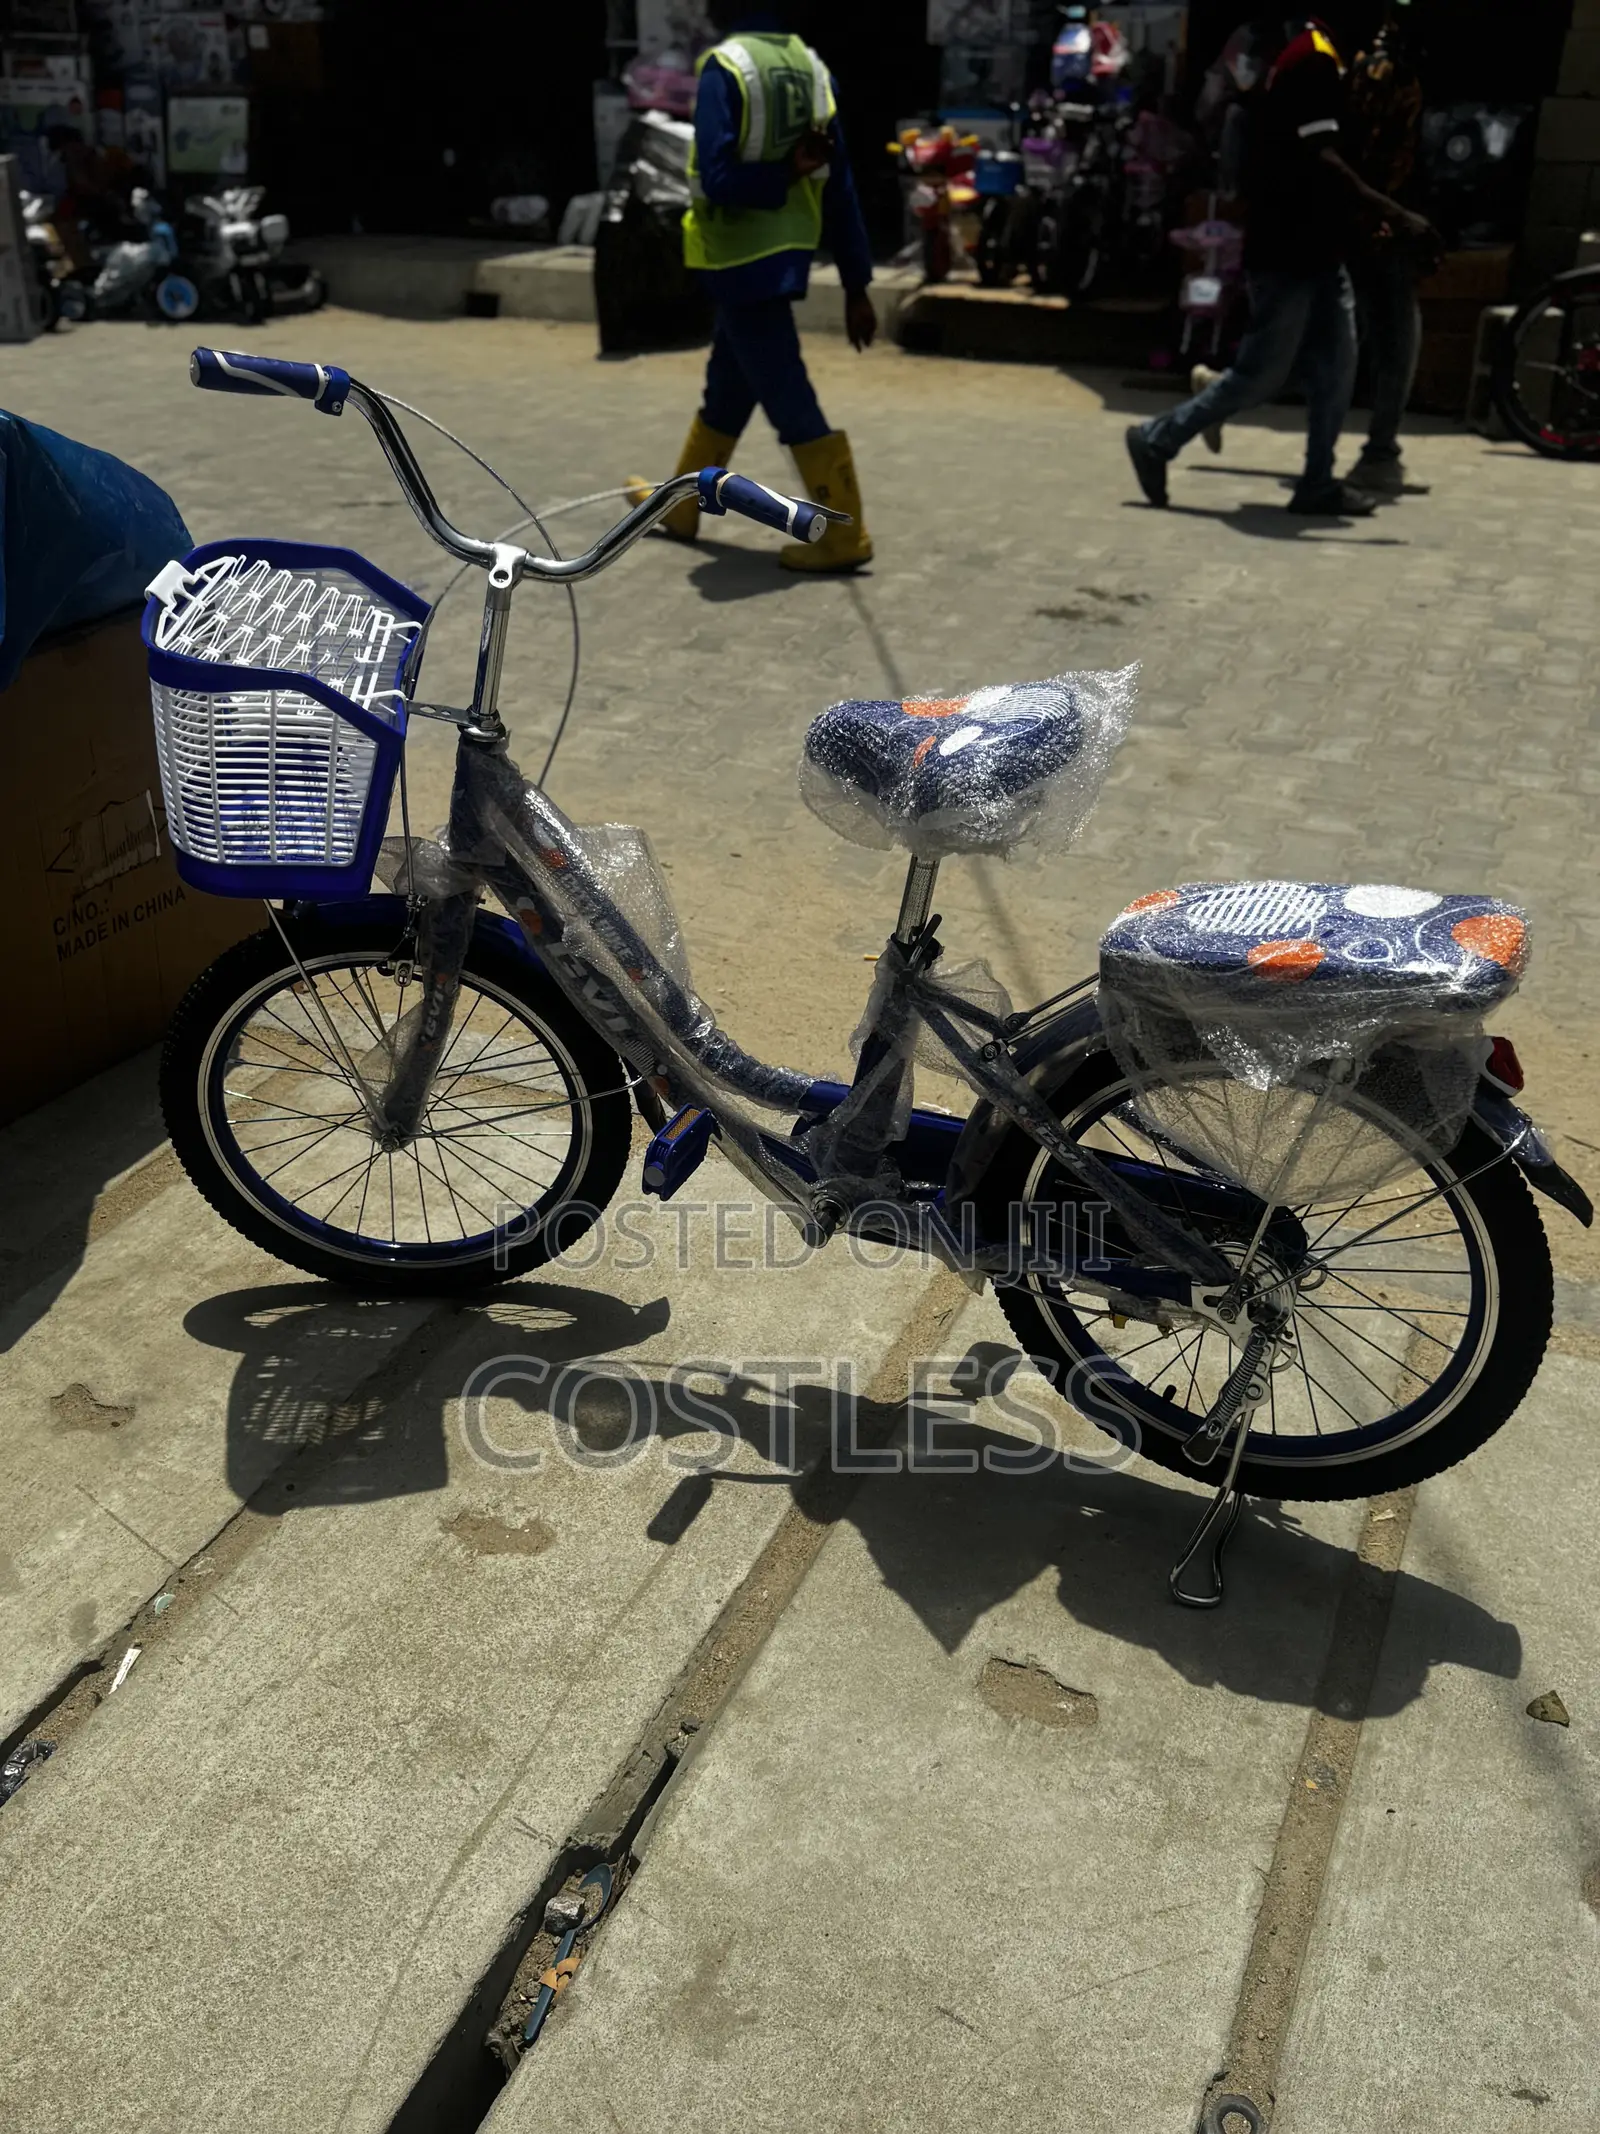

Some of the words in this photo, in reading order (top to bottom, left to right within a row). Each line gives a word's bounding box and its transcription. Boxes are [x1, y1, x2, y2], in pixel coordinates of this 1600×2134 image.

[57, 921, 108, 962] MADE
[112, 911, 129, 934] IN
[134, 885, 186, 922] CHINA
